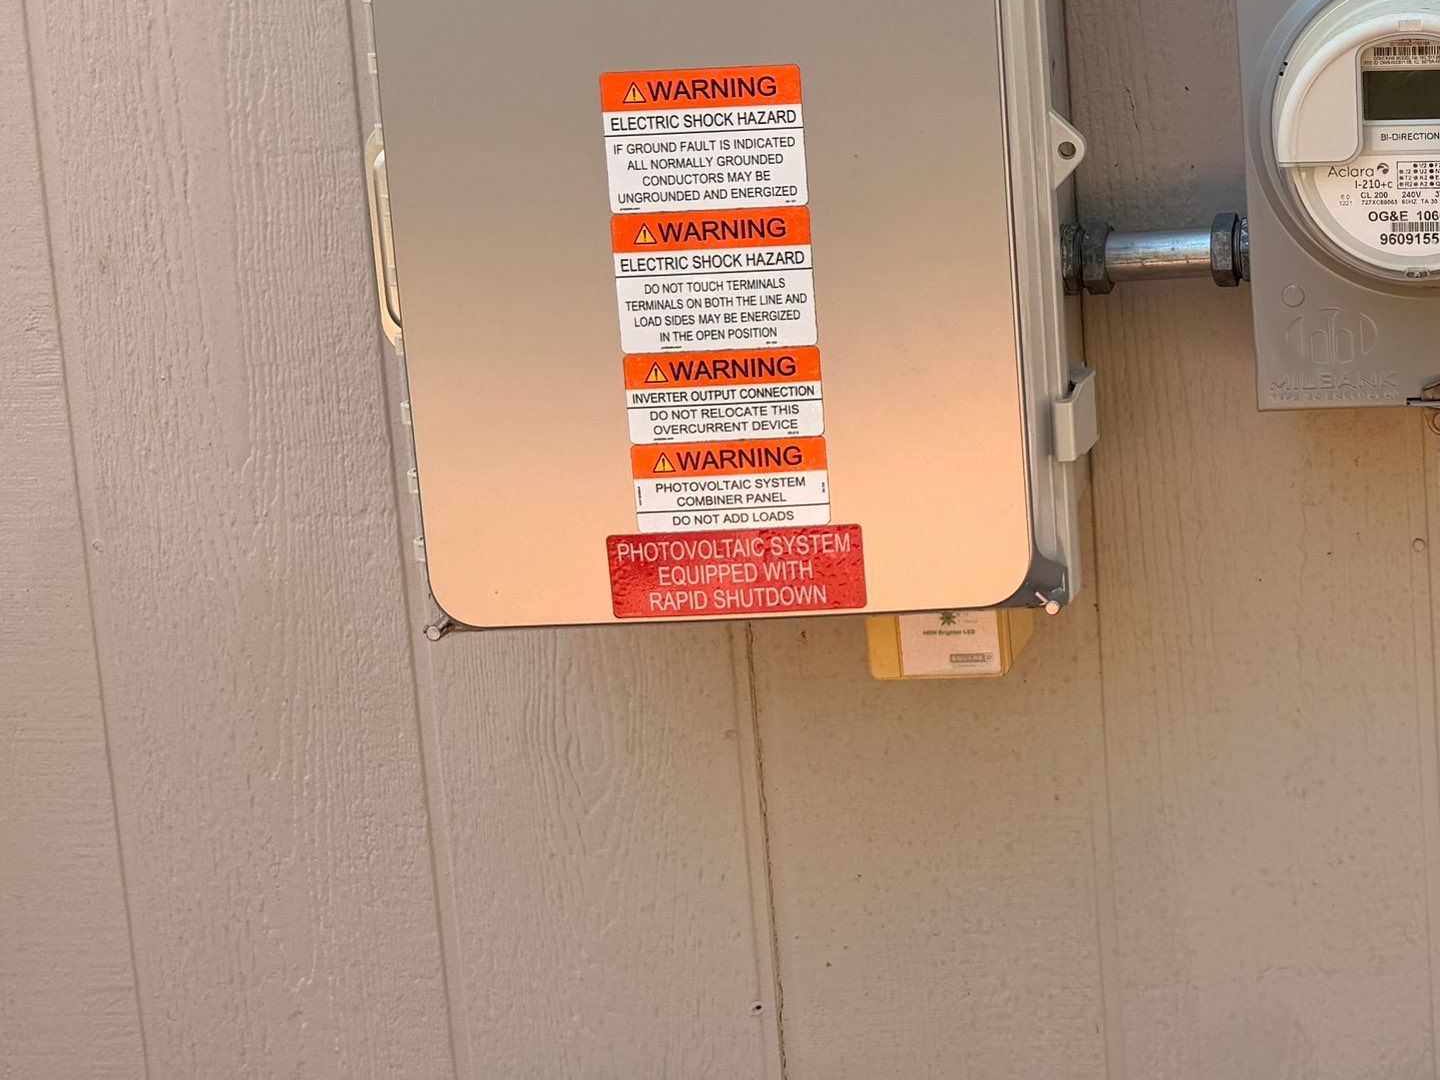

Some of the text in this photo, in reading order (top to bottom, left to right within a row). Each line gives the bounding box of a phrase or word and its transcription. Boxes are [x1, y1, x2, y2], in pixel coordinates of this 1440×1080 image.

[648, 76, 776, 101] WARNING
[611, 110, 796, 131] ELECTRIC SHOCK HAZARD
[613, 136, 795, 155] IF GROUND FAULT IS INDICATED
[628, 154, 783, 170] ALL NORMALLY GROUNDED
[643, 171, 770, 186] CONDUCTORS MAY BE
[1327, 166, 1374, 178] Aclara
[618, 186, 798, 204] UNGROUNDED AND ENERGIZED
[1368, 211, 1408, 221] OG&E
[658, 218, 786, 243] WARNING
[621, 251, 805, 272] ELECTRIC SHOCK HAZARD
[644, 278, 785, 294] DO NOT TOUCH TERMINALS
[626, 293, 807, 311] TERMINALS ON BOTH THE LINE AND
[634, 310, 800, 327] LOAD SIDES MAY BE ENERGIZED
[660, 327, 777, 342] IN THE OPEN POSITION
[669, 356, 796, 381] WARNING
[633, 386, 815, 404] INVERTER OUTPUT CONNECTION
[650, 405, 799, 421] DO NOT RELOCATE THIS
[654, 419, 798, 435] OVERCURRENT DEVICE
[677, 446, 802, 470] WARNING
[656, 477, 805, 492] PHOTOVOLTAIC SYSTEM
[677, 493, 786, 507] COMBINER PANEL
[673, 511, 794, 526] DO NOT ADD LOADS
[617, 533, 851, 562] PHOTOVOLTAIC SYSTEM
[658, 561, 813, 586] EQUIPPED WITH
[650, 585, 827, 611] RAPID SHUTDOWN
